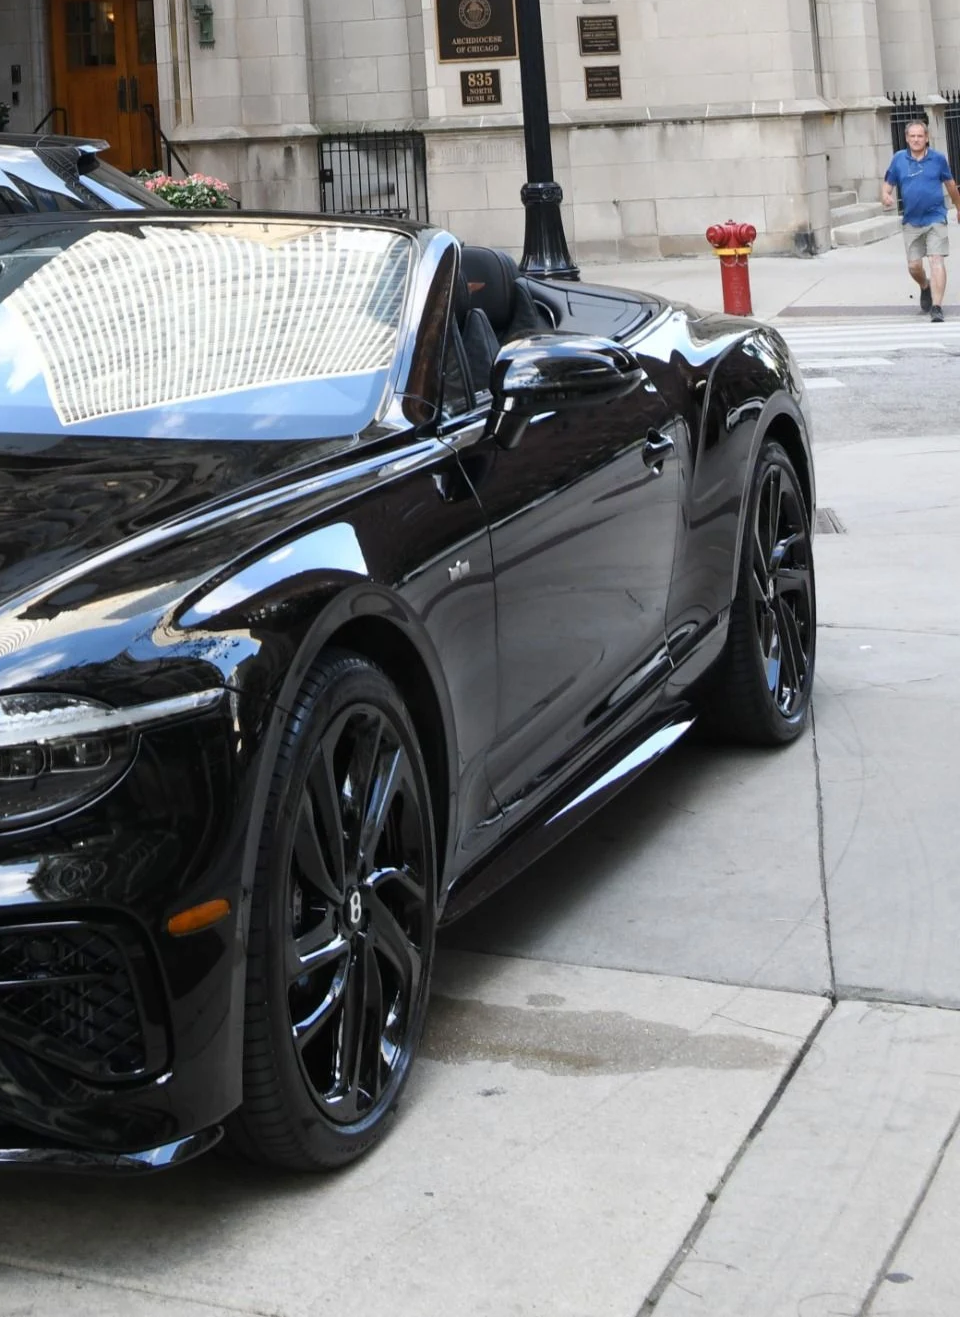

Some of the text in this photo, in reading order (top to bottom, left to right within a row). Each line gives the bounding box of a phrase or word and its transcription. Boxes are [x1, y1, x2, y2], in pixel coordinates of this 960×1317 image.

[451, 36, 503, 45] ARCHDIOCESE
[456, 44, 500, 54] OF CHICAGO
[468, 72, 493, 87] 835
[469, 87, 493, 95] NORTH
[466, 95, 485, 103] RUSH
[350, 890, 362, 924] B
